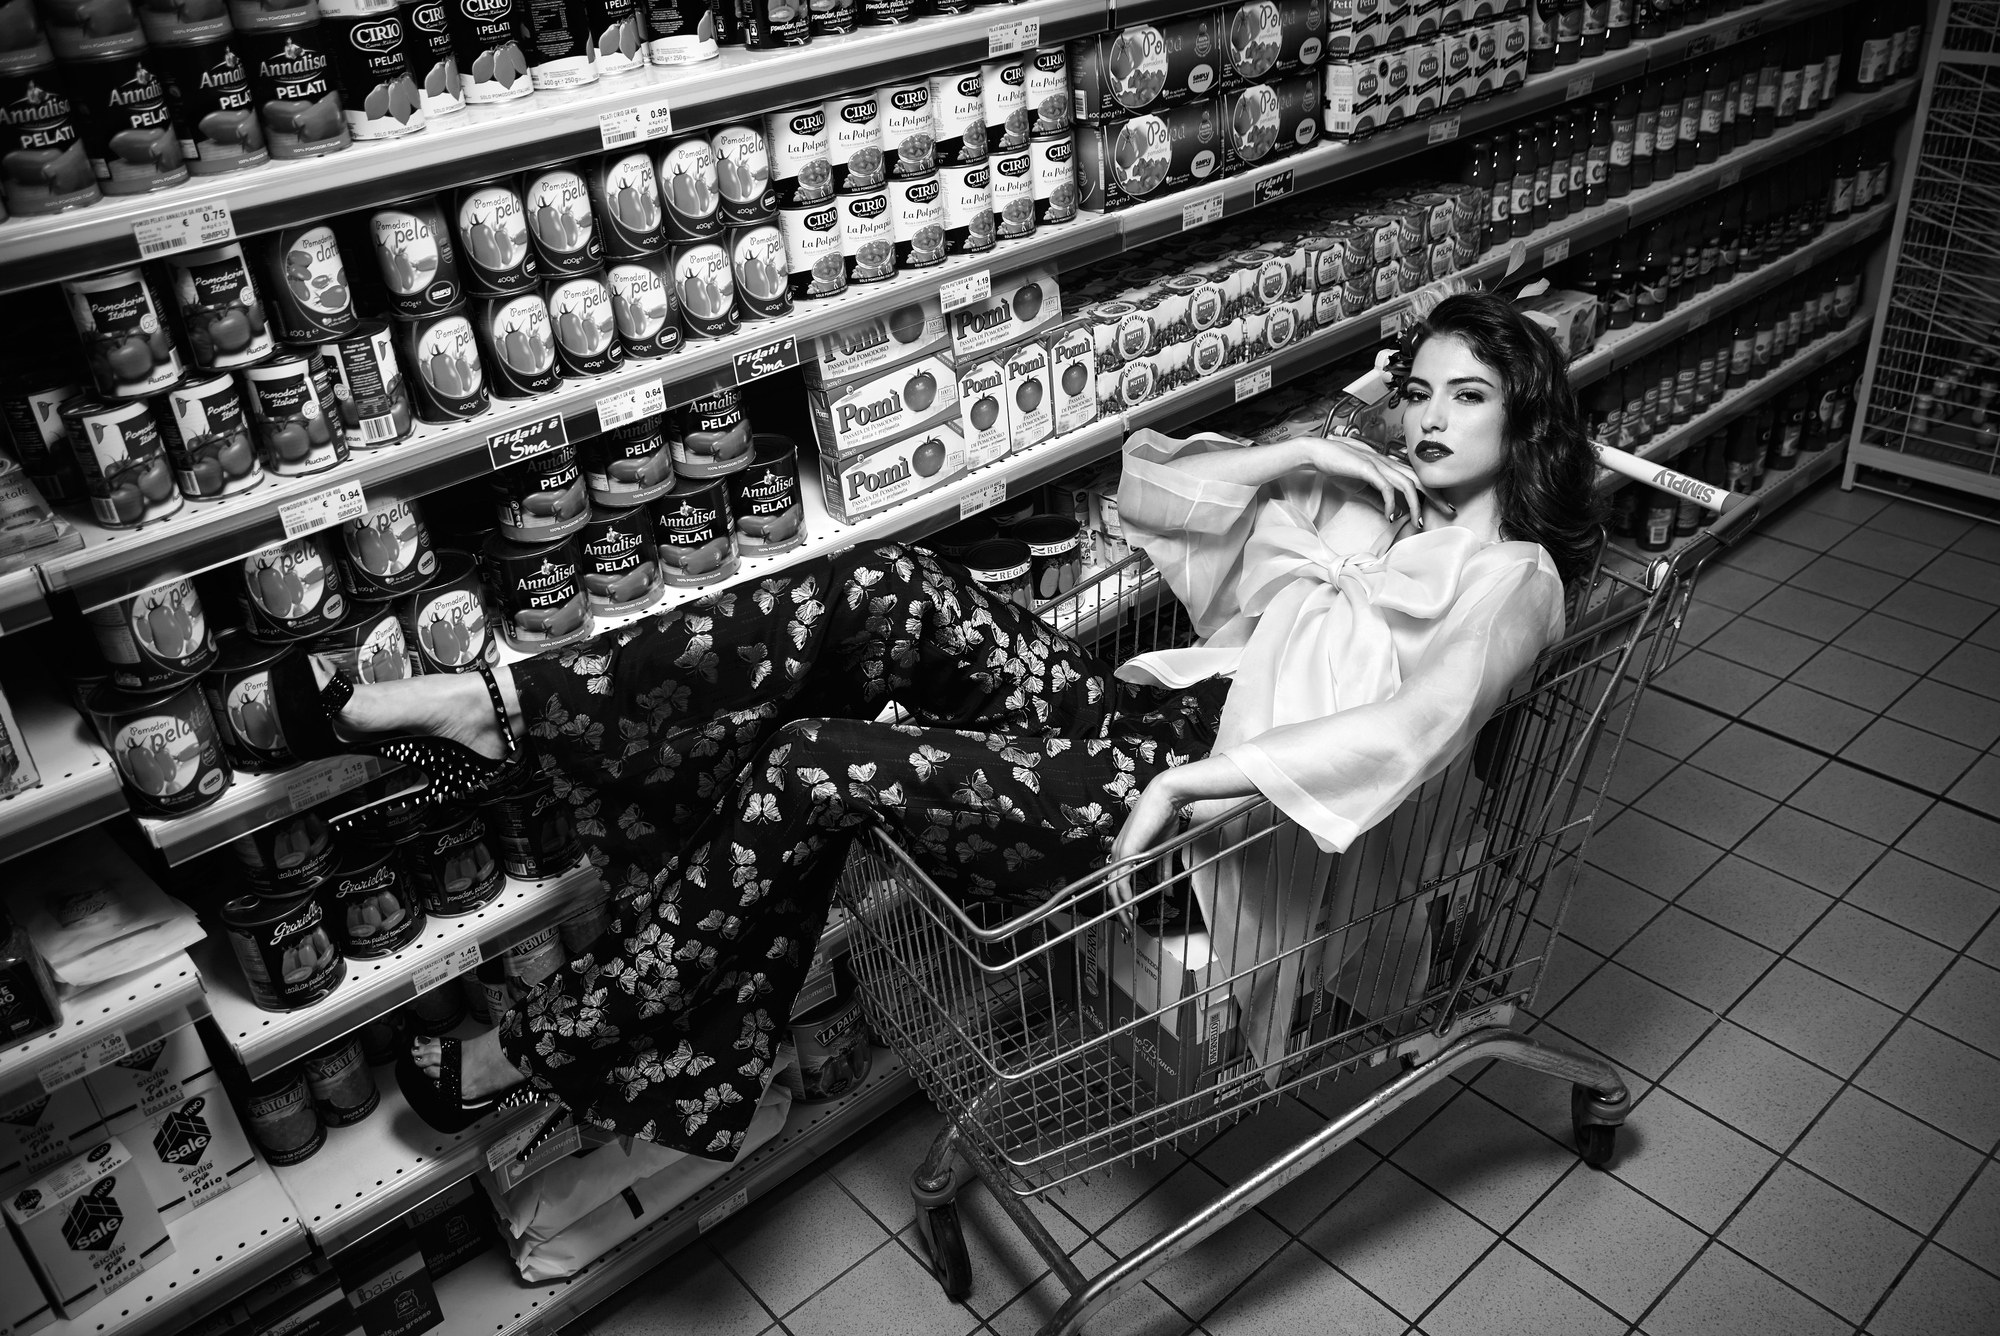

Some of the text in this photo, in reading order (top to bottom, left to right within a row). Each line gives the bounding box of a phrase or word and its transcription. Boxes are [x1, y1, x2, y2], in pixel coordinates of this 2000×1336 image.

[418, 6, 445, 24] CIRI
[356, 23, 400, 44] CIRIO
[482, 22, 511, 35] PELATI
[1025, 23, 1038, 32] 0.73
[260, 53, 328, 77] Annalisa
[375, 52, 404, 66] PELATI
[1037, 52, 1065, 67] CIRIO
[276, 80, 327, 99] PELATI
[895, 89, 927, 106] CIRIO
[220, 89, 251, 109] PELA
[650, 107, 667, 118] 0.99
[844, 103, 877, 119] CIRIO
[793, 114, 825, 131] CIRIO
[20, 125, 75, 149] PELATI
[1001, 156, 1029, 172] CIRIO
[908, 183, 938, 199] CIRIO
[1263, 186, 1285, 201] Sma
[852, 197, 885, 214] CIRIO
[203, 208, 226, 222] 0.75
[806, 209, 837, 227] CIRIO
[976, 277, 989, 287] 1.19
[738, 343, 780, 366] Fidati
[751, 358, 785, 376] Sma
[645, 387, 662, 399] 0.64
[701, 411, 741, 431] PELATI
[493, 424, 543, 449] Fidati
[509, 438, 551, 461] Sma
[625, 436, 663, 457] PELATI
[540, 467, 579, 490] PELATI
[741, 475, 795, 499] Annalisa
[340, 489, 360, 502] 0.94
[753, 496, 792, 515] PELATI
[659, 508, 717, 529] Annalisa
[584, 532, 643, 557] Annalisa
[670, 529, 713, 544] PELATI
[1046, 540, 1073, 555] REGA
[596, 555, 640, 573] PELATI
[999, 566, 1025, 580] REGA
[517, 562, 576, 592] Annalisa
[530, 585, 575, 608] PELATI
[460, 945, 477, 958] 1.42
[101, 1036, 122, 1049] 1.99
[184, 1100, 202, 1117] FINO
[167, 1134, 208, 1163] sale
[188, 1175, 222, 1198] iodio
[76, 1217, 120, 1250] sale
[100, 1258, 136, 1285] iodio
